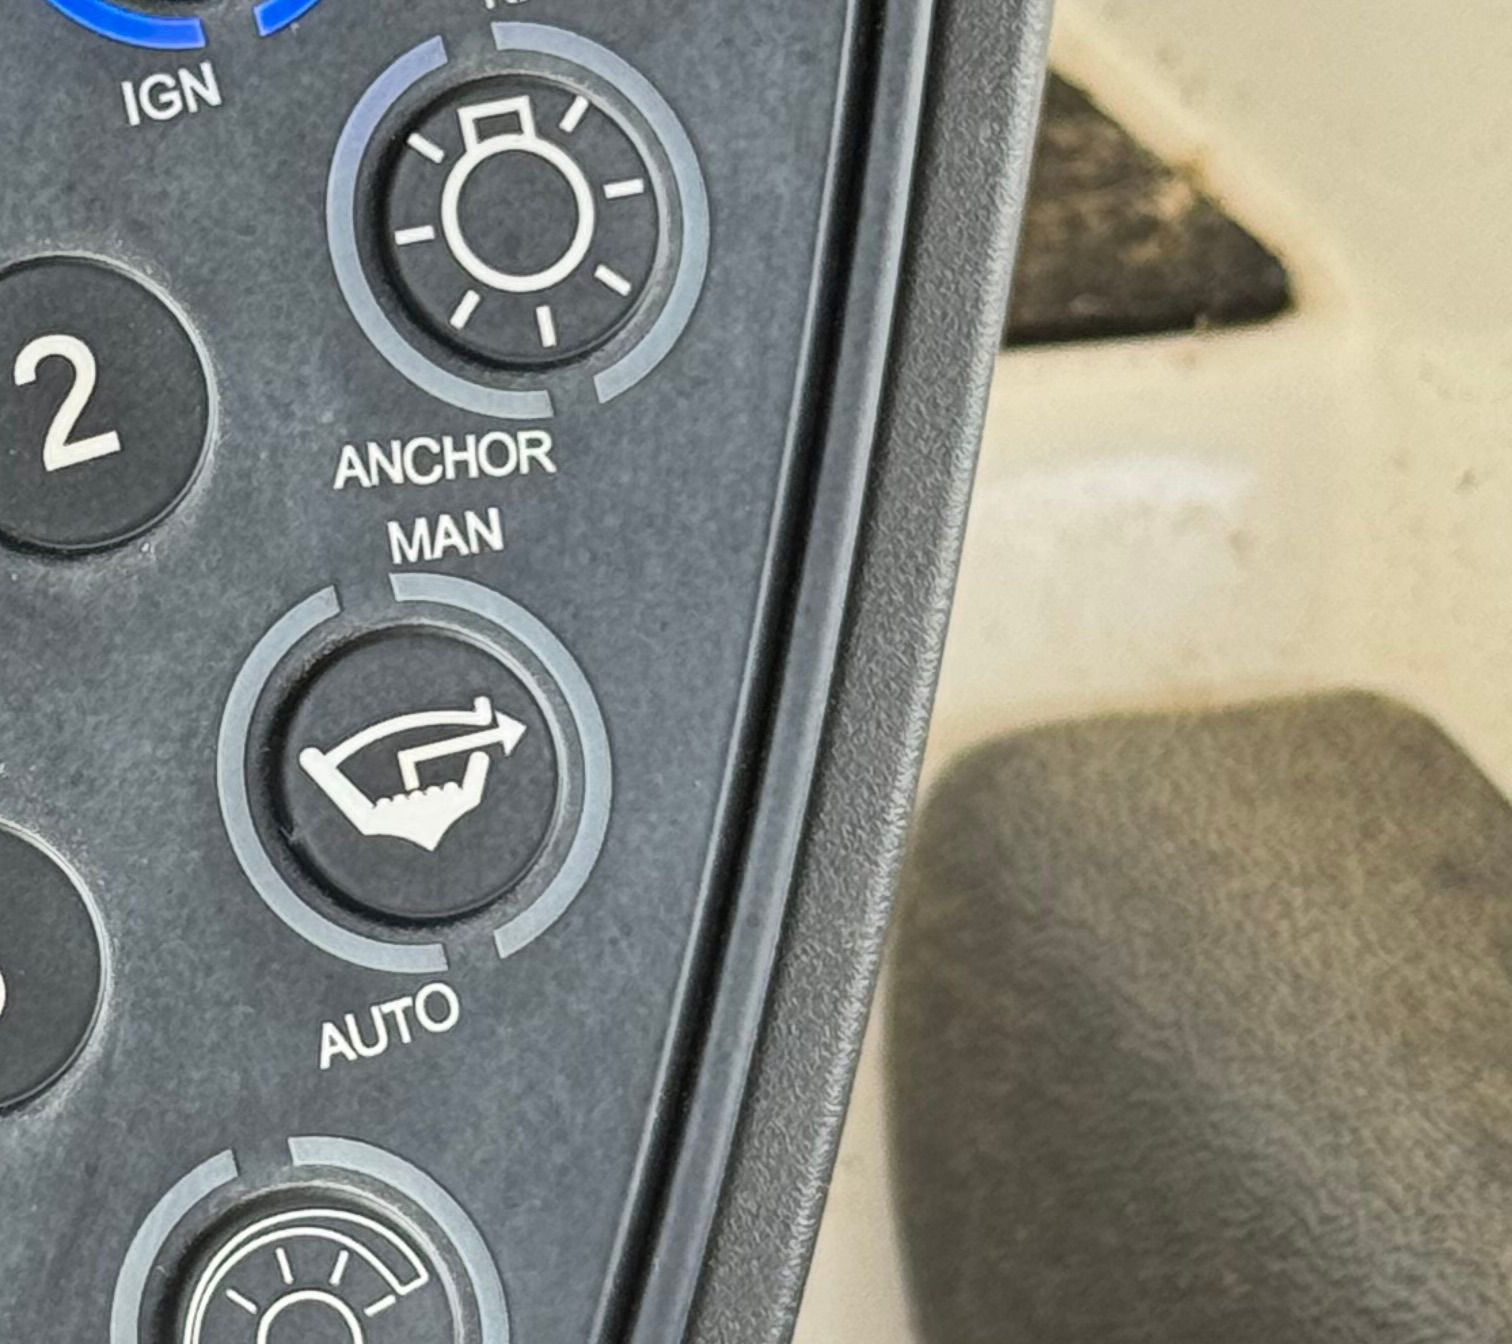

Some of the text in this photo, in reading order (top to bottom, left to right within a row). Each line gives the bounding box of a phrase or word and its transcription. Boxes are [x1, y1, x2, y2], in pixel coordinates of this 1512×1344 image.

[121, 62, 222, 126] IGN
[13, 334, 121, 472] 2
[333, 430, 557, 489] ANCHOR
[387, 508, 504, 564] MAN
[317, 982, 461, 1069] AUTO
